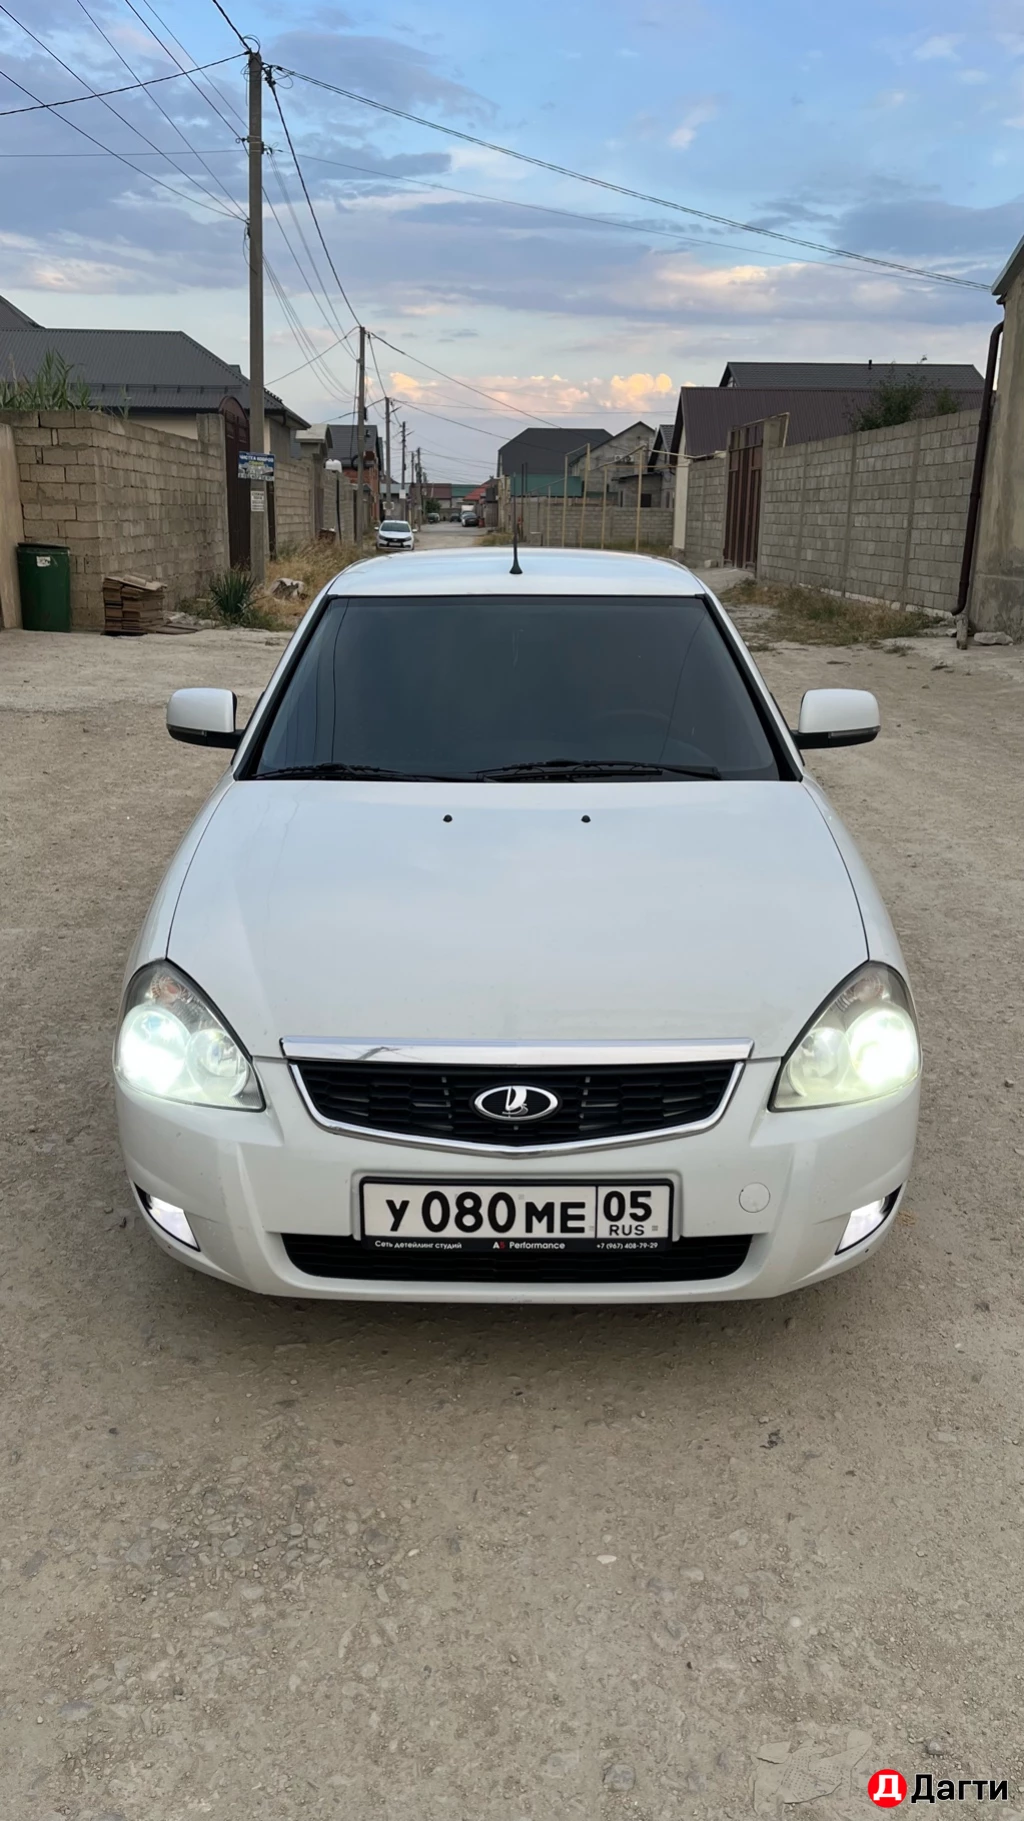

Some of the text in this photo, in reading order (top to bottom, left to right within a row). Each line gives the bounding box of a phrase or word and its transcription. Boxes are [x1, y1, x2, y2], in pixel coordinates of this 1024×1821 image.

[603, 1190, 653, 1223] 05
[609, 1224, 645, 1236] RUS
[374, 1240, 463, 1250] Сеть детейлинг студий
[509, 1241, 566, 1250] Performance
